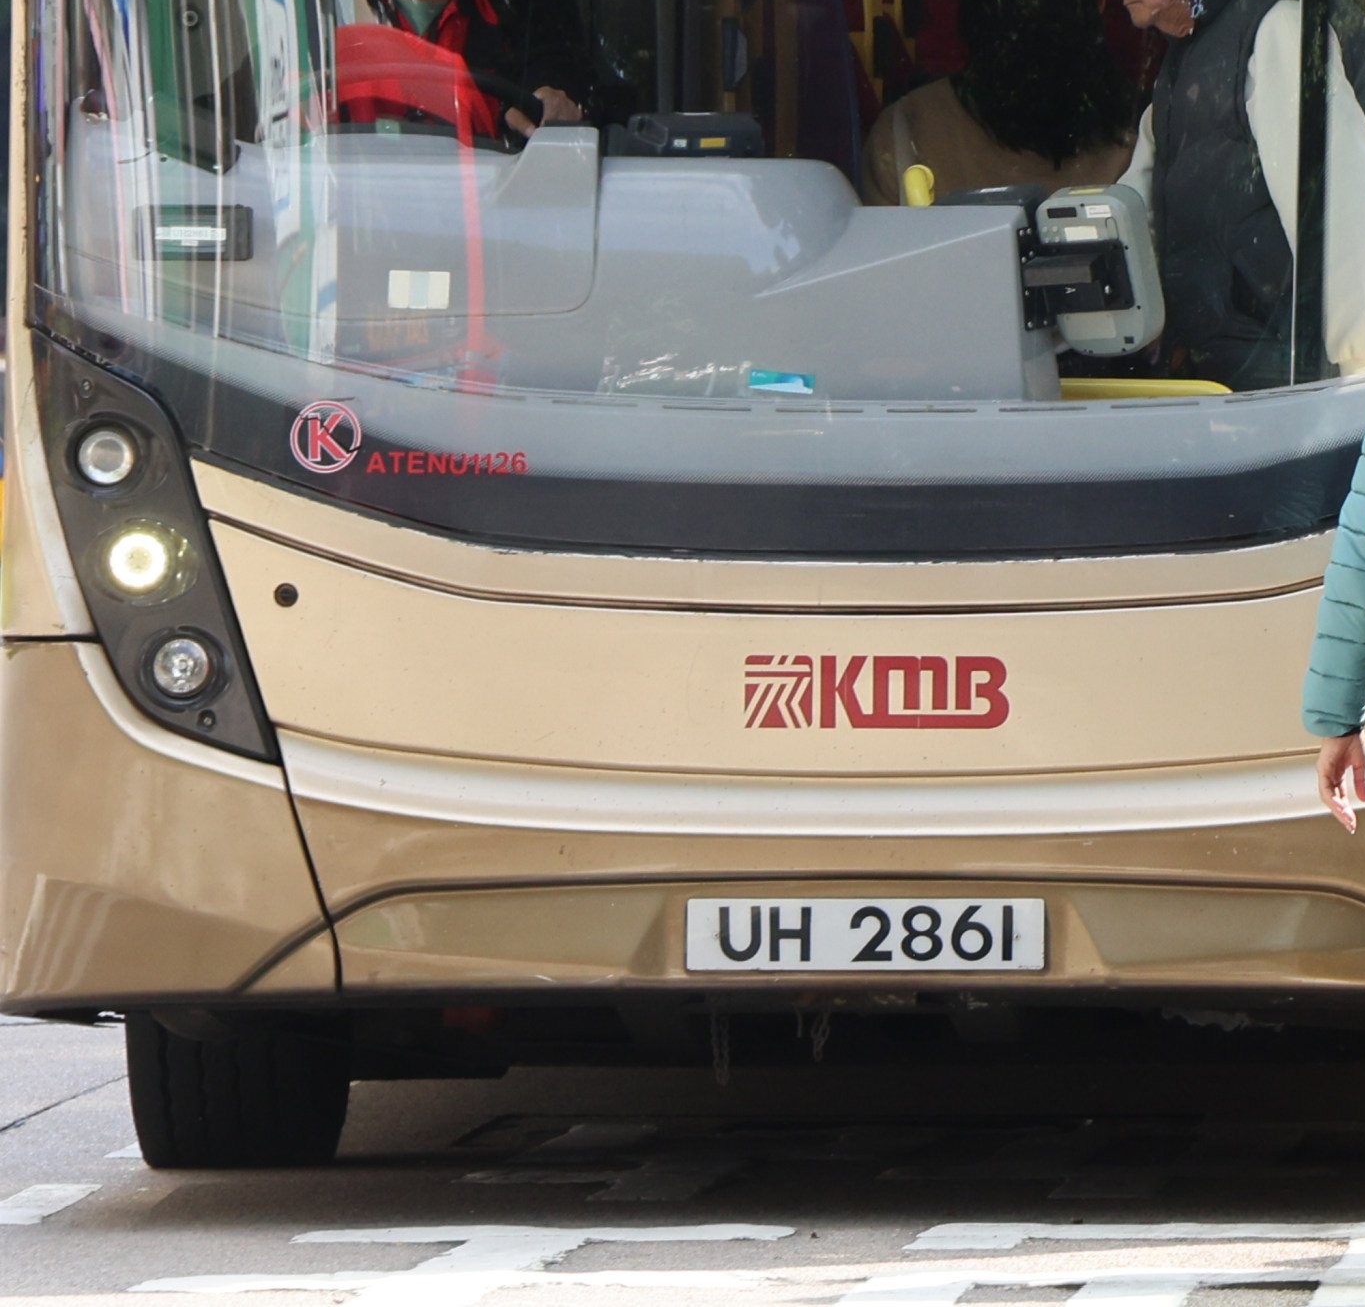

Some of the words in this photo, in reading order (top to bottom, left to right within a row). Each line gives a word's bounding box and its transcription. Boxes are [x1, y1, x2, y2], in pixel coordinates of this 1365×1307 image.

[366, 451, 529, 476] ATENU1126
[818, 654, 1010, 730] KMB
[718, 905, 812, 963] UH
[849, 905, 1015, 964] 2861
